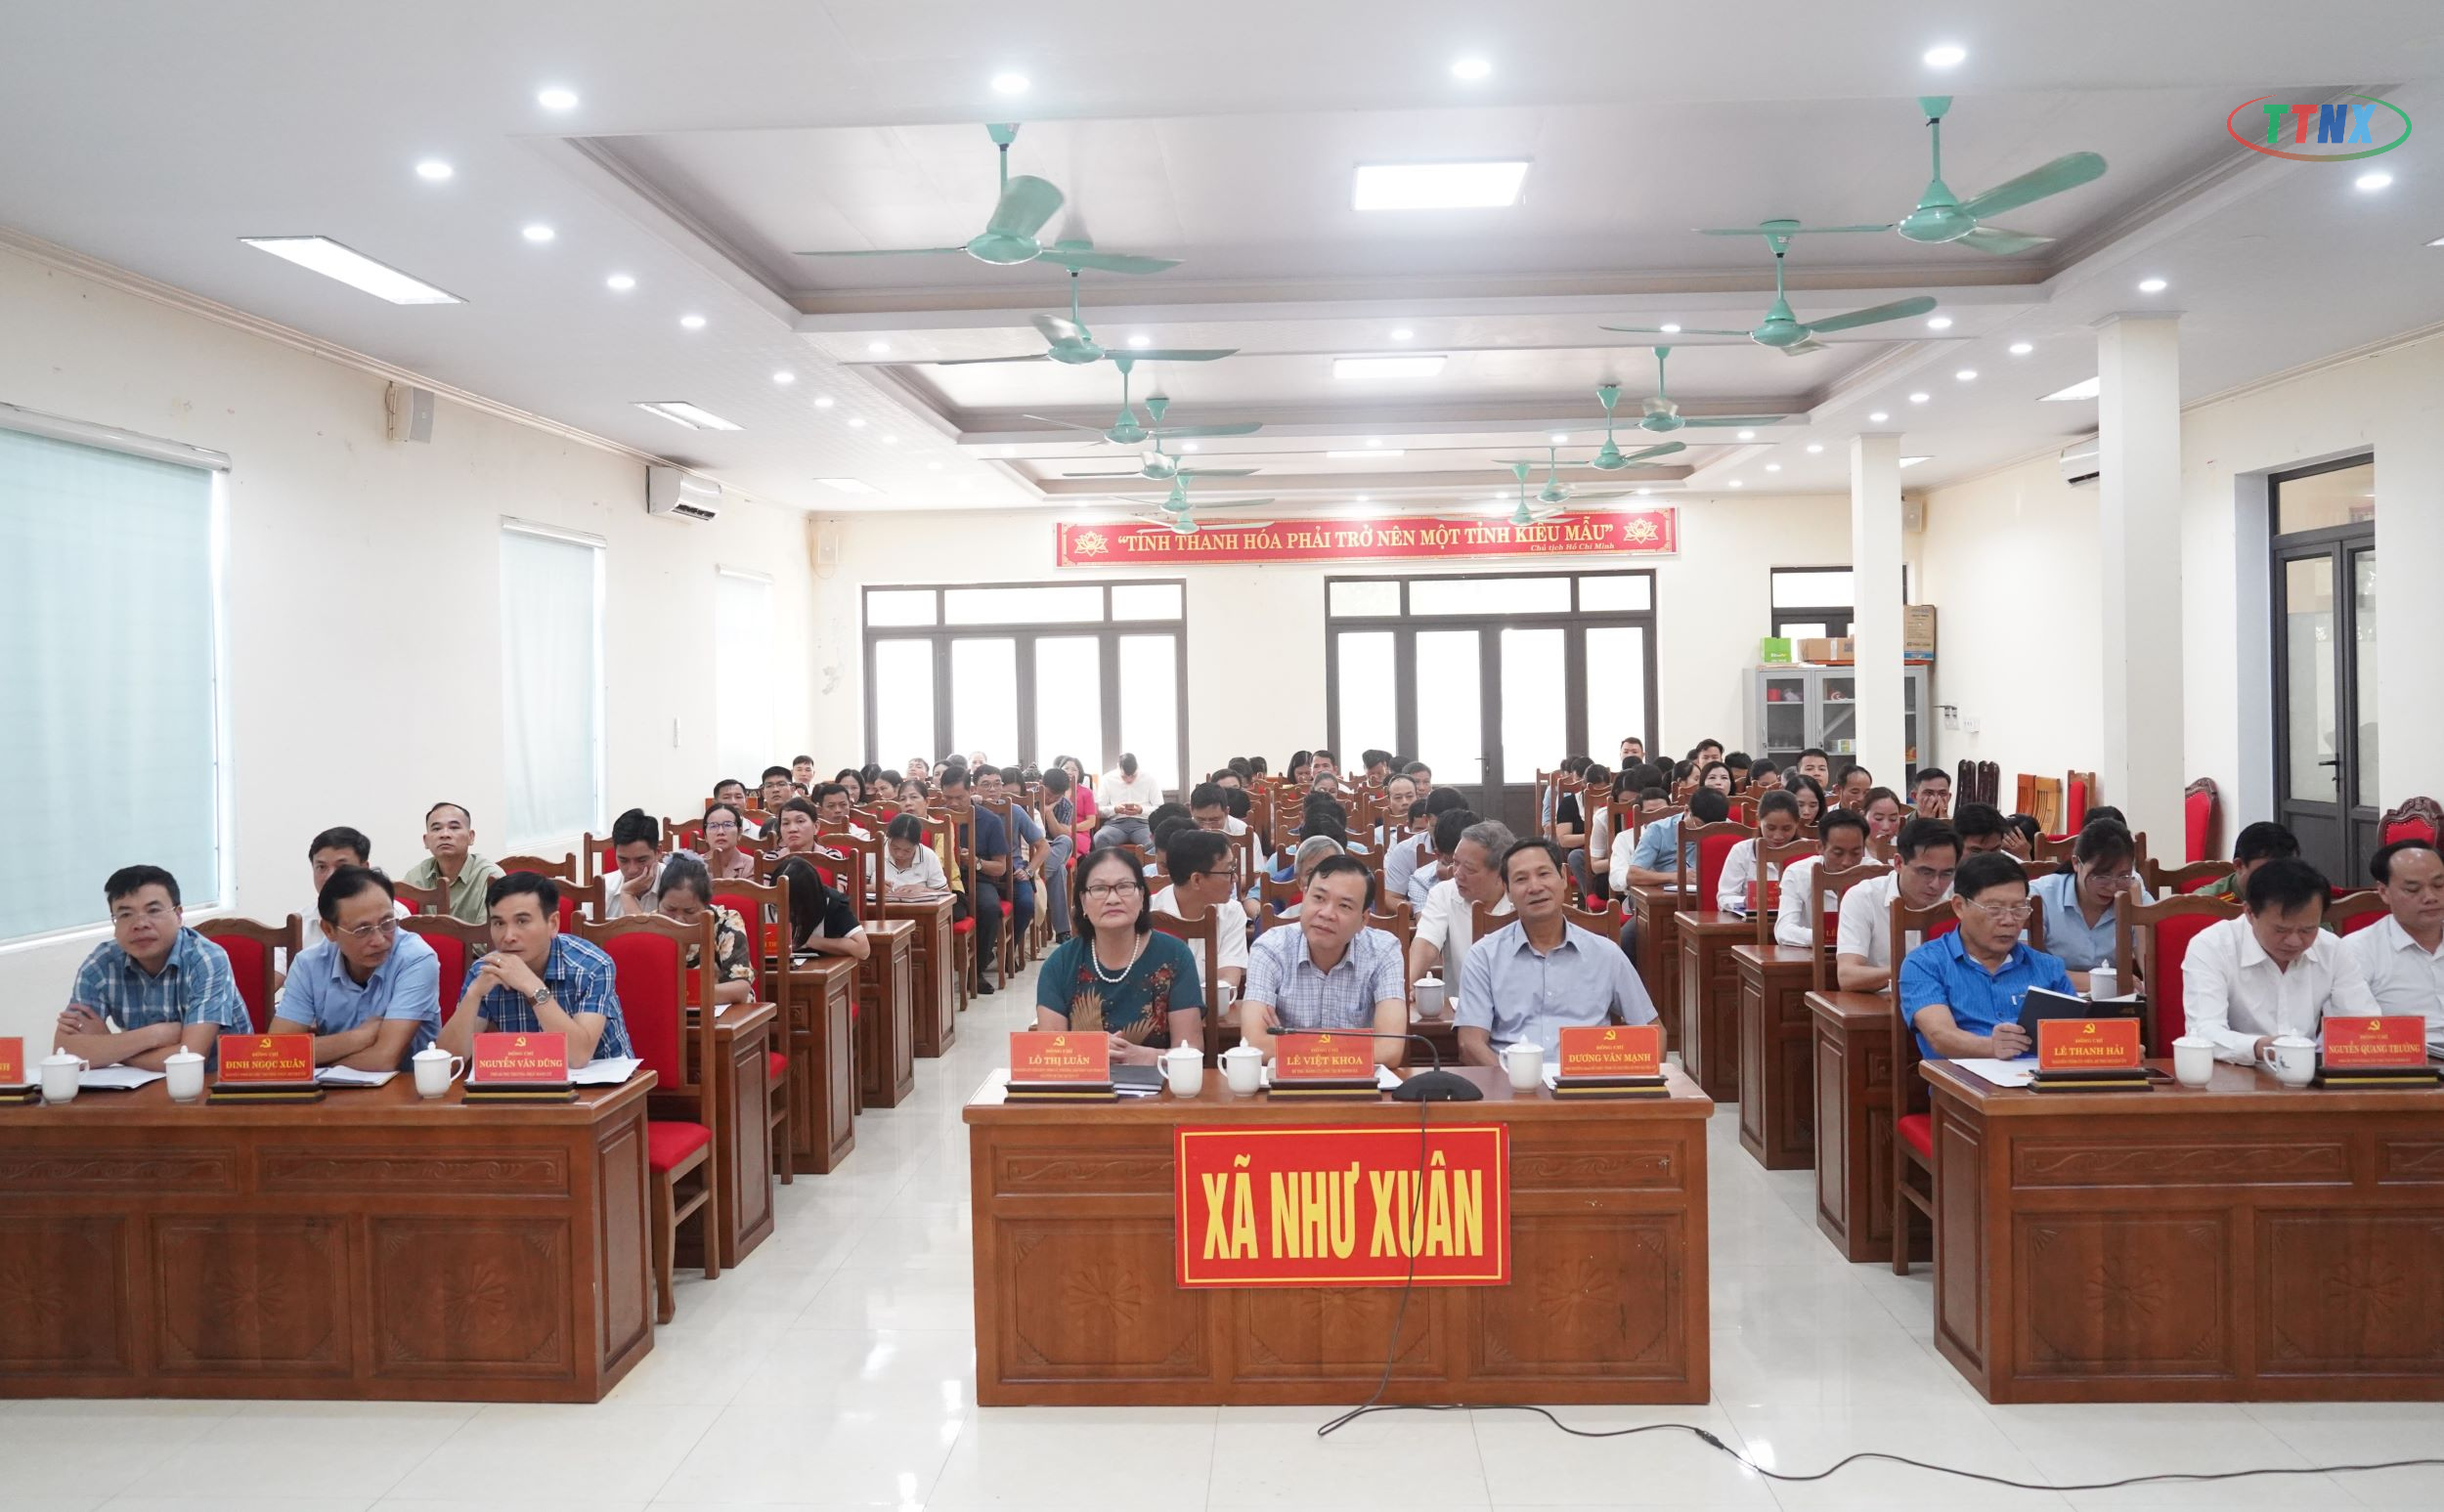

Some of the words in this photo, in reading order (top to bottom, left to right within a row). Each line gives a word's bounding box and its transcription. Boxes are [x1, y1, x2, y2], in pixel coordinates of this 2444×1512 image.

[1175, 535, 1239, 550] THANH
[1244, 529, 1283, 549] HÓA
[1287, 525, 1331, 548] PHẢI
[1335, 524, 1373, 547] TRỞ
[1376, 526, 1416, 546] NÊN
[1419, 524, 1461, 549] MỘT
[1464, 521, 1510, 544] TỈNH
[2069, 1047, 2103, 1056] THANH
[2107, 1044, 2124, 1056] HẢI
[2361, 1045, 2387, 1055] QUANG
[1044, 1056, 1061, 1066] THỊ
[1287, 1055, 1300, 1065] LÊ
[1303, 1054, 1330, 1066] VIỆT
[1331, 1056, 1363, 1065] KHOA
[1569, 1054, 1601, 1062] DƯƠNG
[252, 1060, 278, 1070] NGỌC
[1201, 1153, 1259, 1260] XÃ
[1270, 1161, 1360, 1259] NHƯ
[1369, 1149, 1484, 1258] XUÂN
